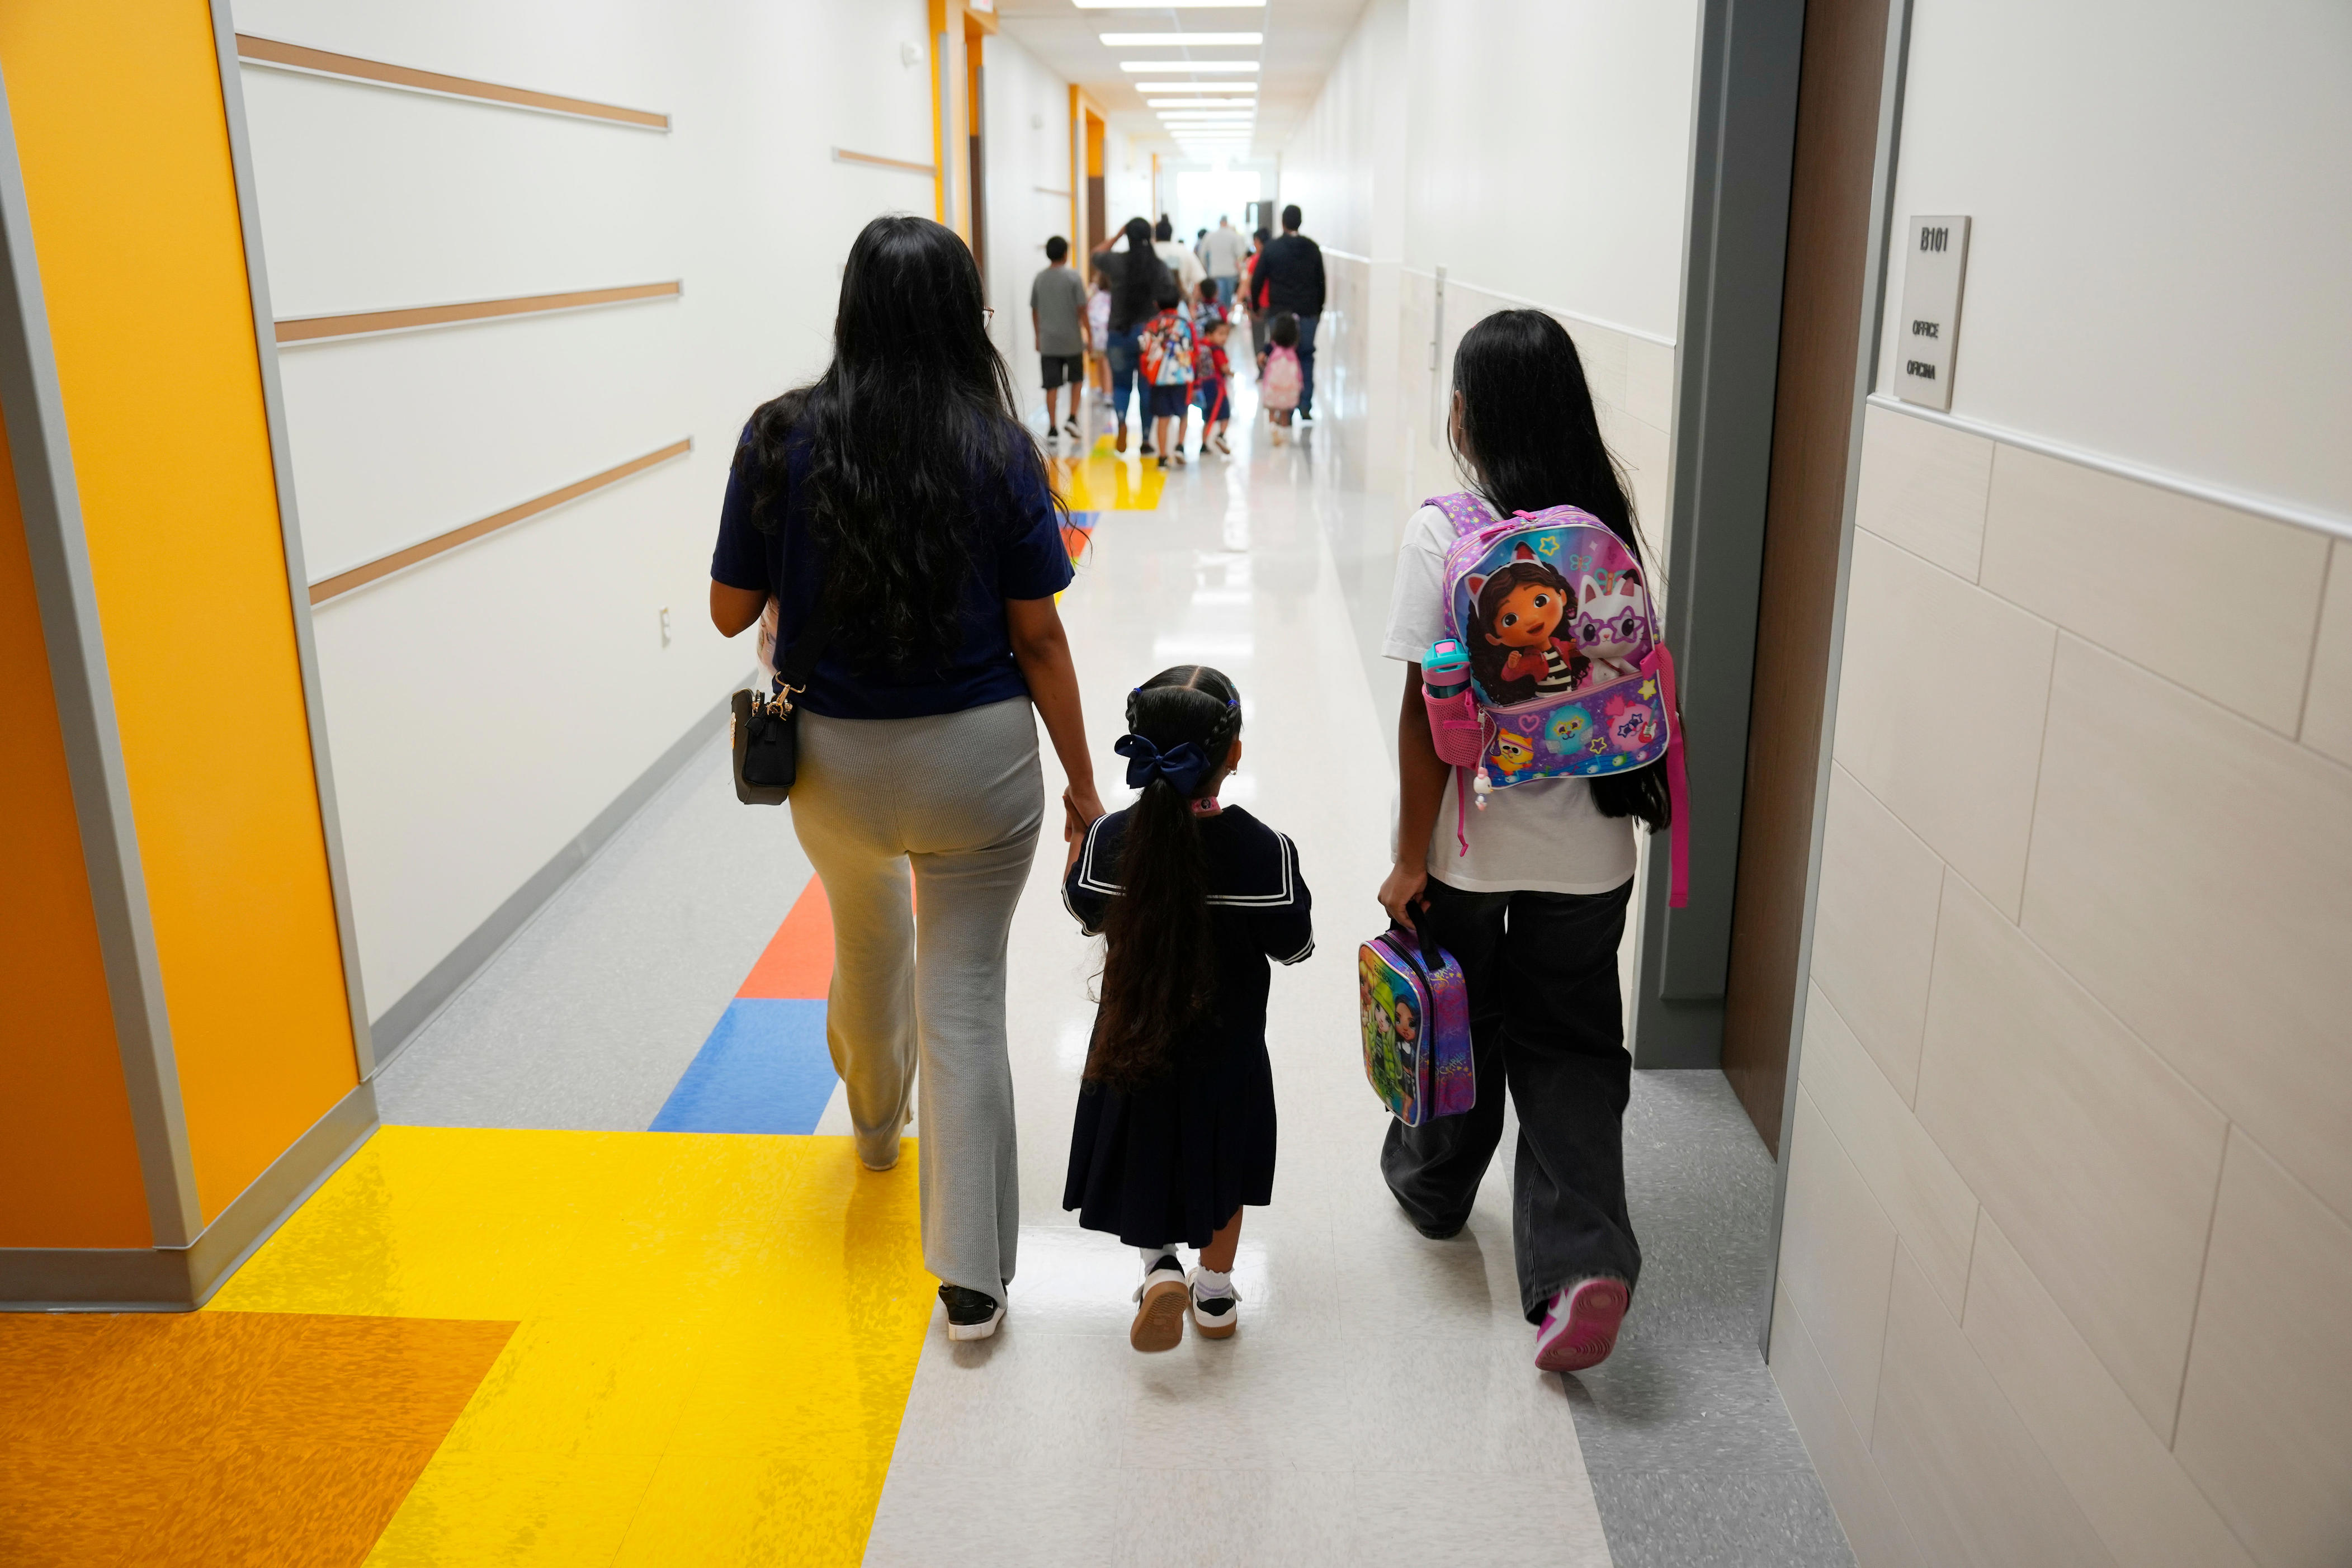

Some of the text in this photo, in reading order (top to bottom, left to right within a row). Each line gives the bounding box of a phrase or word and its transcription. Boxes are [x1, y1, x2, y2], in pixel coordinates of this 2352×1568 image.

[1920, 226, 1949, 252] B101
[1912, 320, 1939, 338] OFFICE
[1906, 360, 1935, 380] OFICINA
